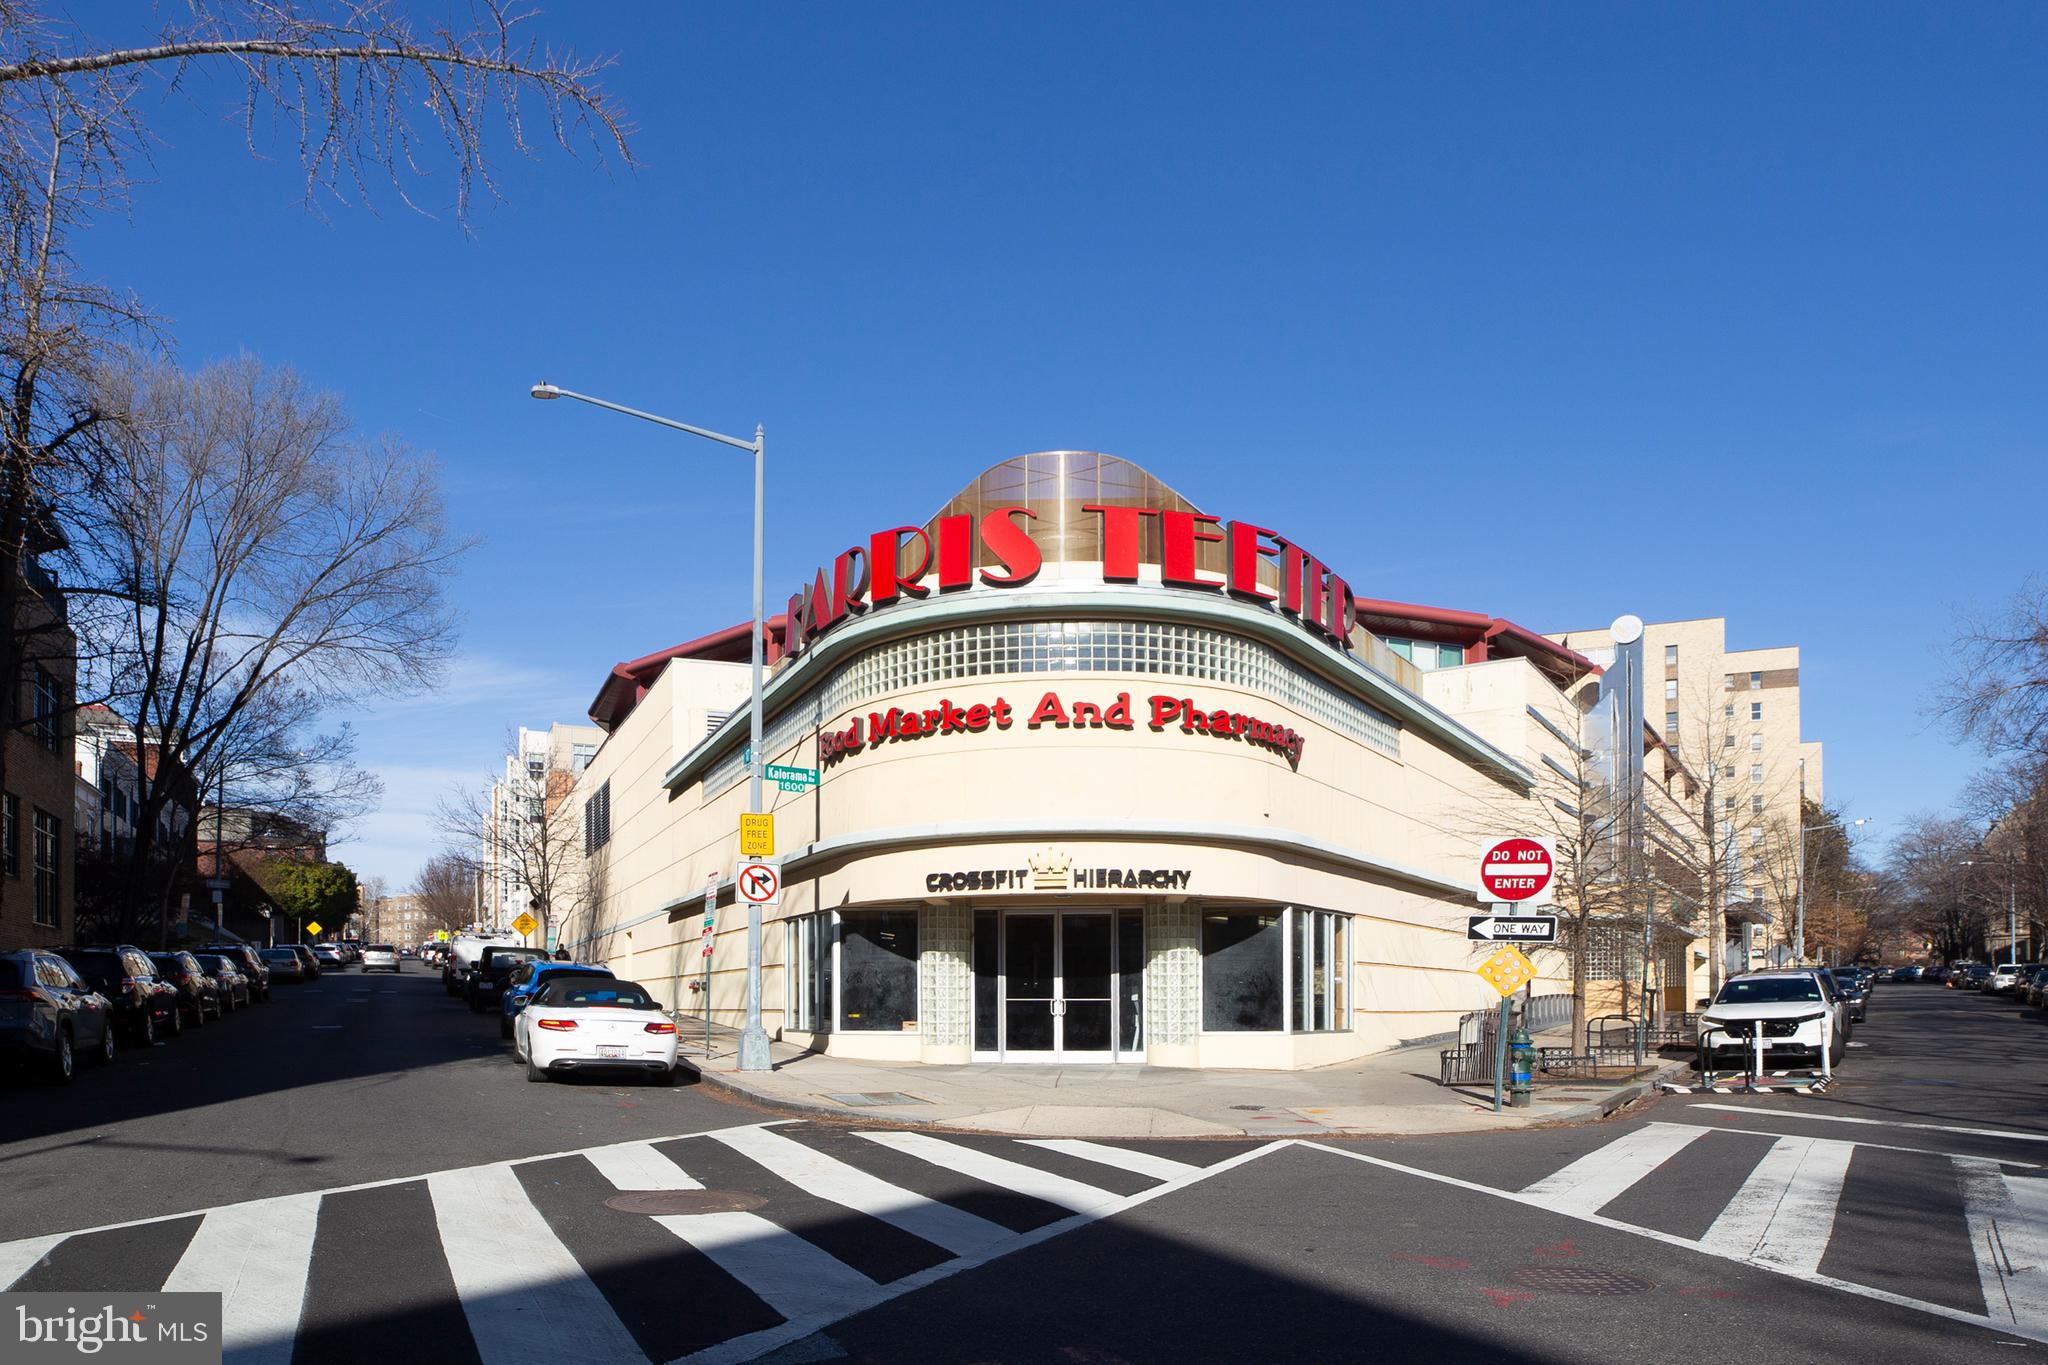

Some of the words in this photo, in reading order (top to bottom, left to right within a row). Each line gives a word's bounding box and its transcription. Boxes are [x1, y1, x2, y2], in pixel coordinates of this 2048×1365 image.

[785, 505, 1042, 658] HARRIS
[1082, 504, 1356, 650] TEETER
[819, 717, 865, 762] Food
[868, 697, 1013, 746] Market
[1028, 692, 1134, 730] And
[1149, 695, 1306, 766] Pharmacy
[768, 767, 808, 782] Kalorama
[780, 781, 804, 792] 1600
[745, 818, 769, 827] DRUG
[746, 830, 768, 838] FREE
[747, 841, 768, 850] ZONE
[1492, 850, 1510, 861] DO
[1517, 850, 1543, 861] NOT
[926, 869, 1028, 893] CROSSFIT
[1073, 868, 1191, 890] HIERARCHY
[1494, 878, 1536, 889] ENTER
[1493, 923, 1517, 935] ONE
[1521, 923, 1546, 935] WAY
